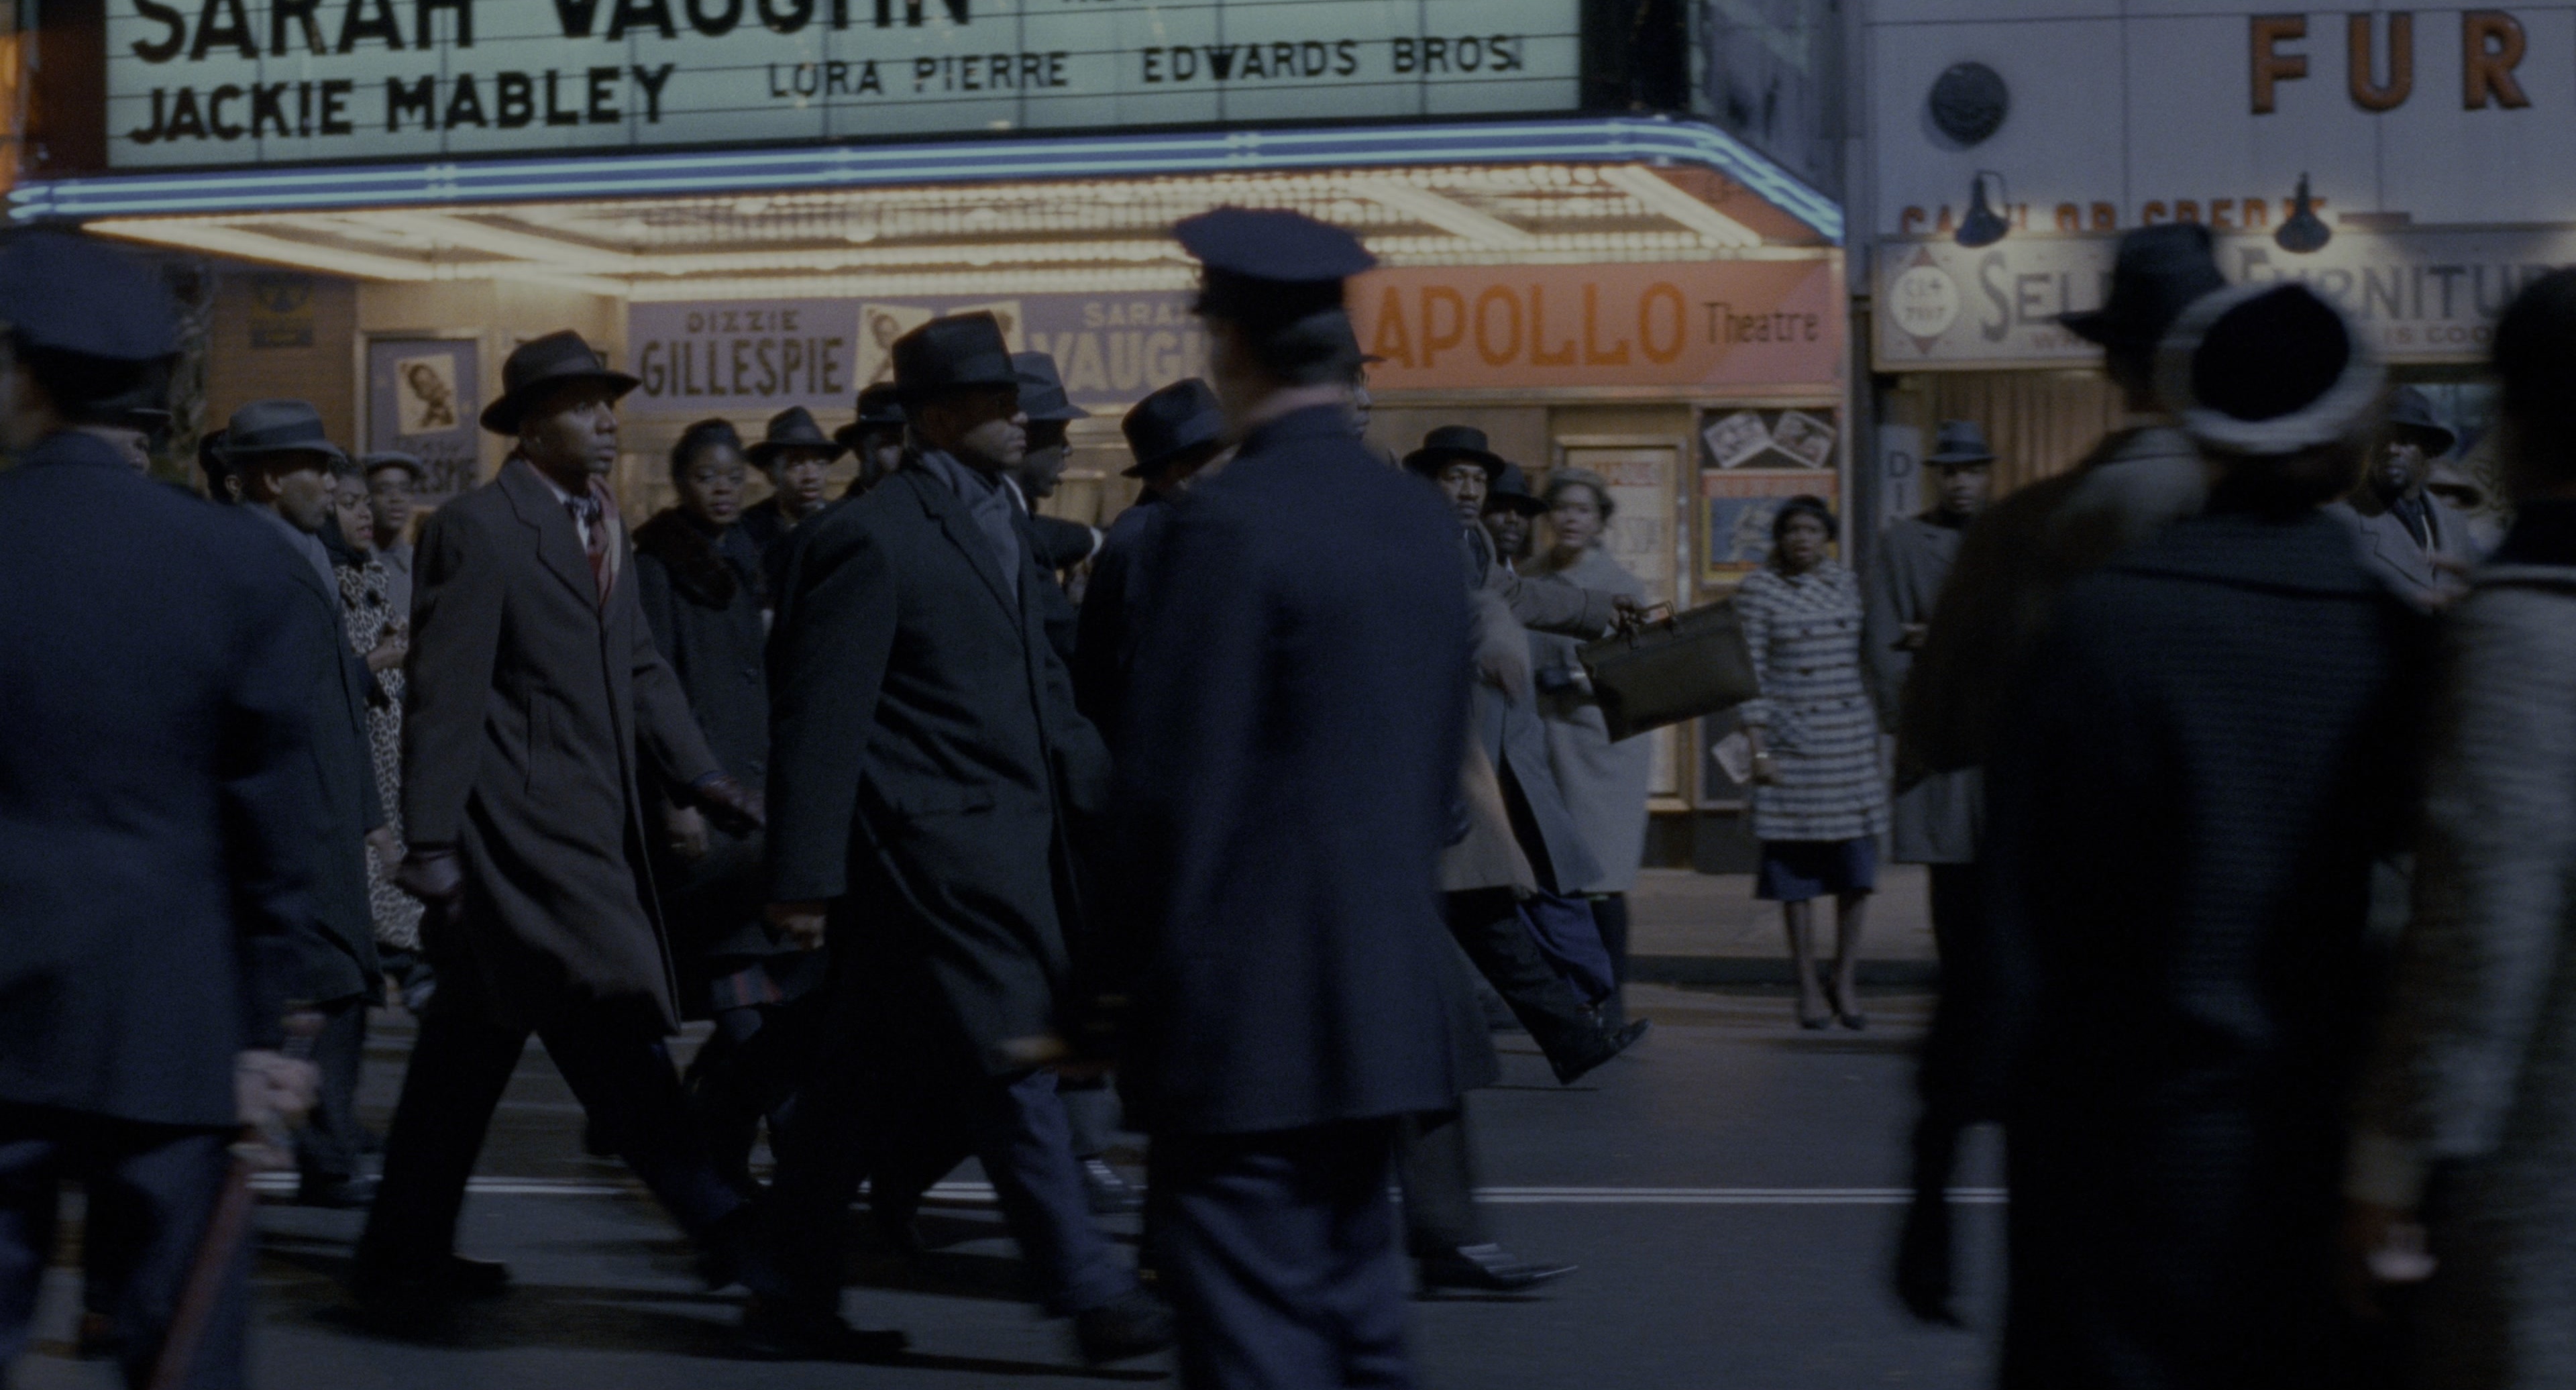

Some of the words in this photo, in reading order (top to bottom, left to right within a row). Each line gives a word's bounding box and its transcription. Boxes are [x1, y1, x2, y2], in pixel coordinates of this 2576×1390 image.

[131, 0, 472, 62] SARAH
[1142, 40, 1358, 83] EDWARDS
[131, 81, 352, 144] JACKIE
[386, 64, 674, 132] MABLEY
[769, 60, 882, 97] LORA
[914, 52, 1070, 93] PIERRE
[688, 309, 800, 333] DIZZIE
[1371, 280, 1688, 370] APOLLO
[1701, 301, 1819, 344] Theatre
[639, 336, 845, 397] GILLESPIE
